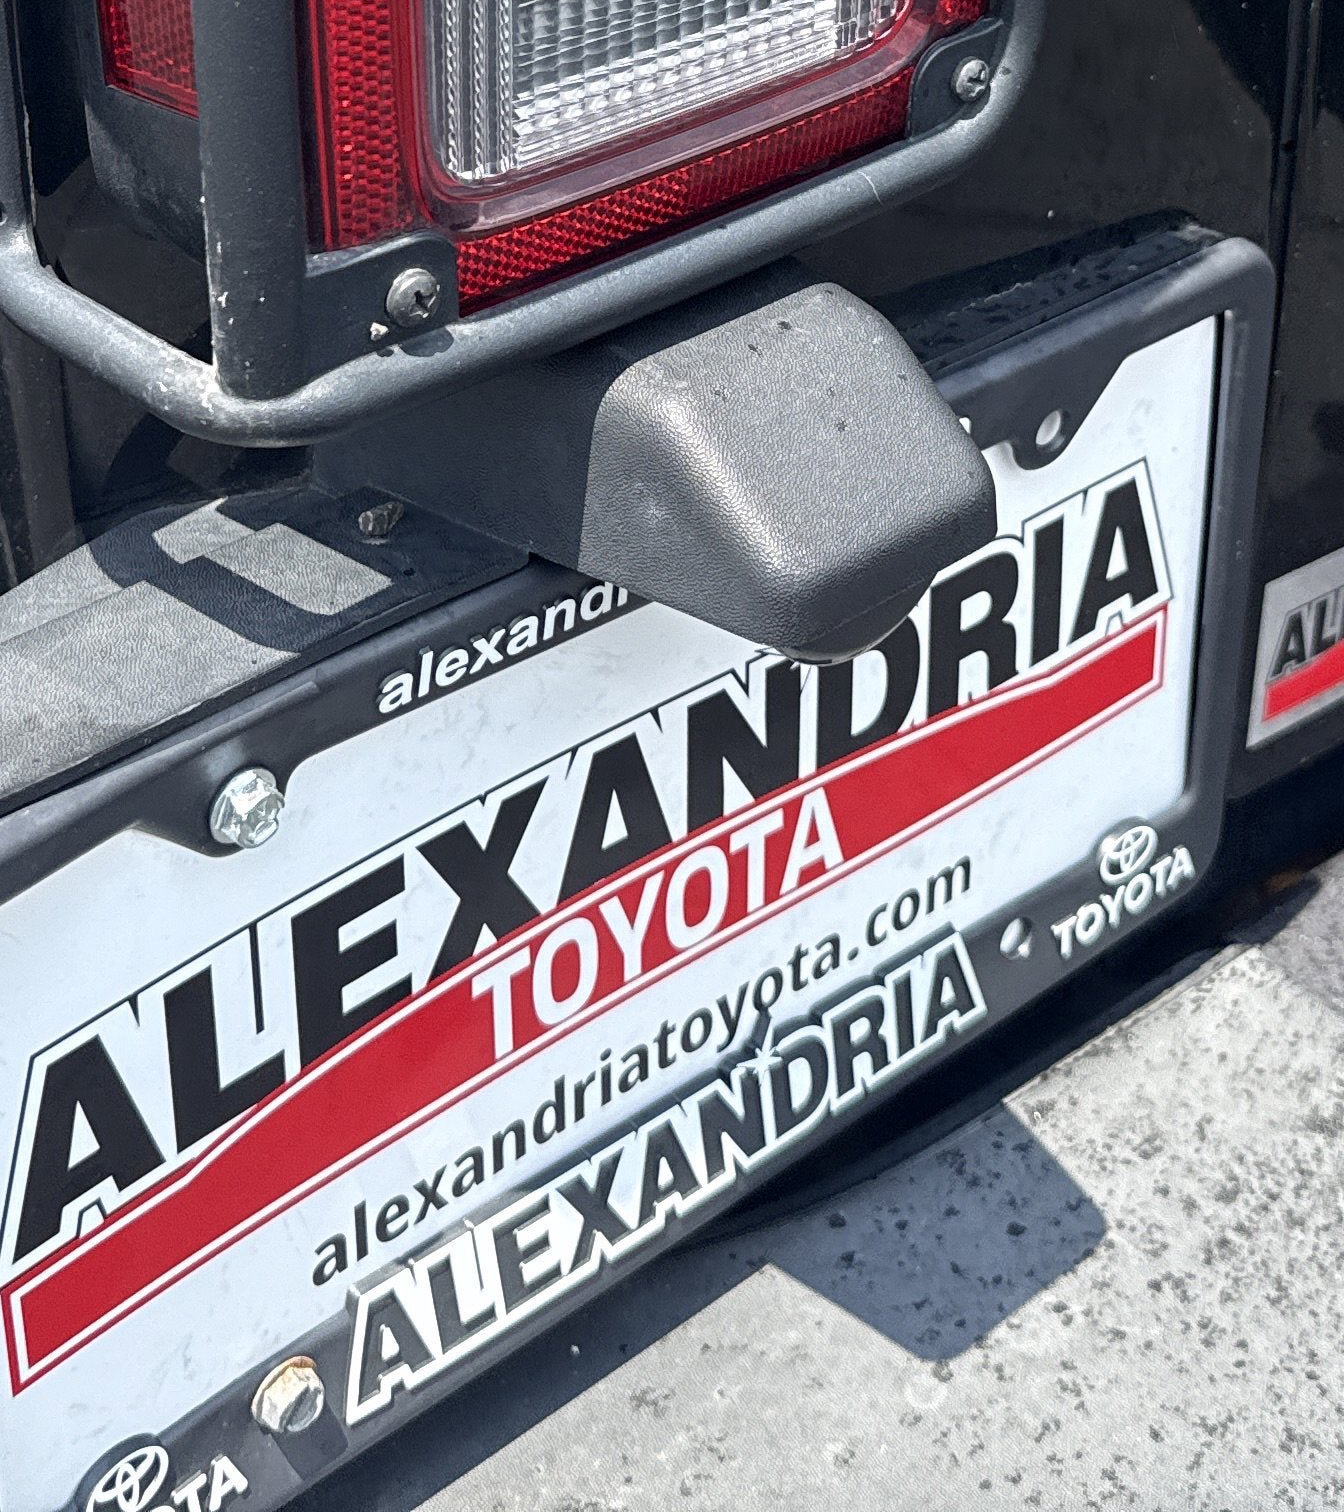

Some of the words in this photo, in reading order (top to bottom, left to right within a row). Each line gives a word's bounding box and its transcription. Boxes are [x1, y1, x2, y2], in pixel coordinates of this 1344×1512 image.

[8, 474, 1162, 1268] ALEXANDRIA
[311, 855, 972, 1286] alexandriatoyota.com
[470, 786, 845, 1062] TOYOTA
[1050, 845, 1197, 960] TOYOTA
[349, 934, 984, 1422] ALEXANDRIA
